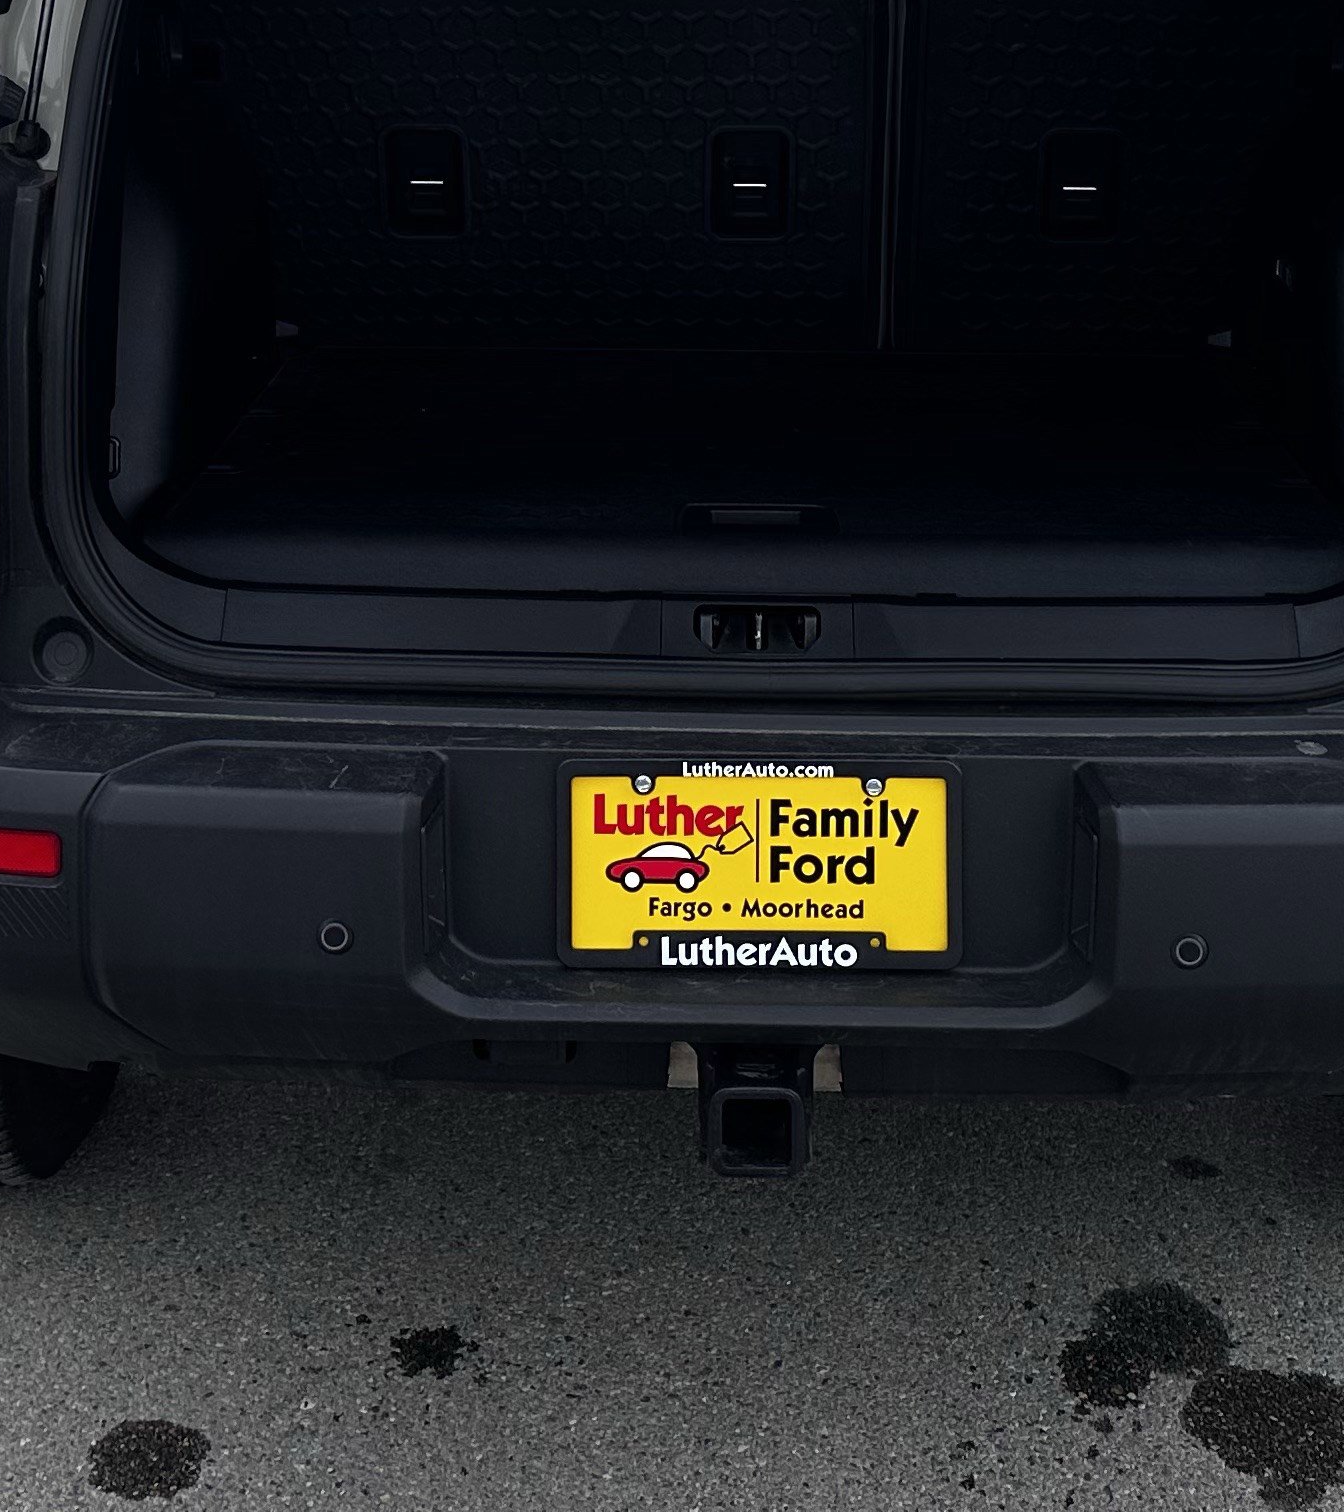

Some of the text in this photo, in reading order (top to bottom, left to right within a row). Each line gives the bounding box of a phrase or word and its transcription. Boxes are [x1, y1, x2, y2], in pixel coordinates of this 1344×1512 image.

[682, 761, 834, 778] LutherAuto.com
[593, 793, 745, 837] Luther
[769, 797, 919, 847] Family
[769, 845, 875, 885] Ford
[648, 896, 864, 921] Fargo Moorhead
[661, 935, 858, 967] LutherAuto
